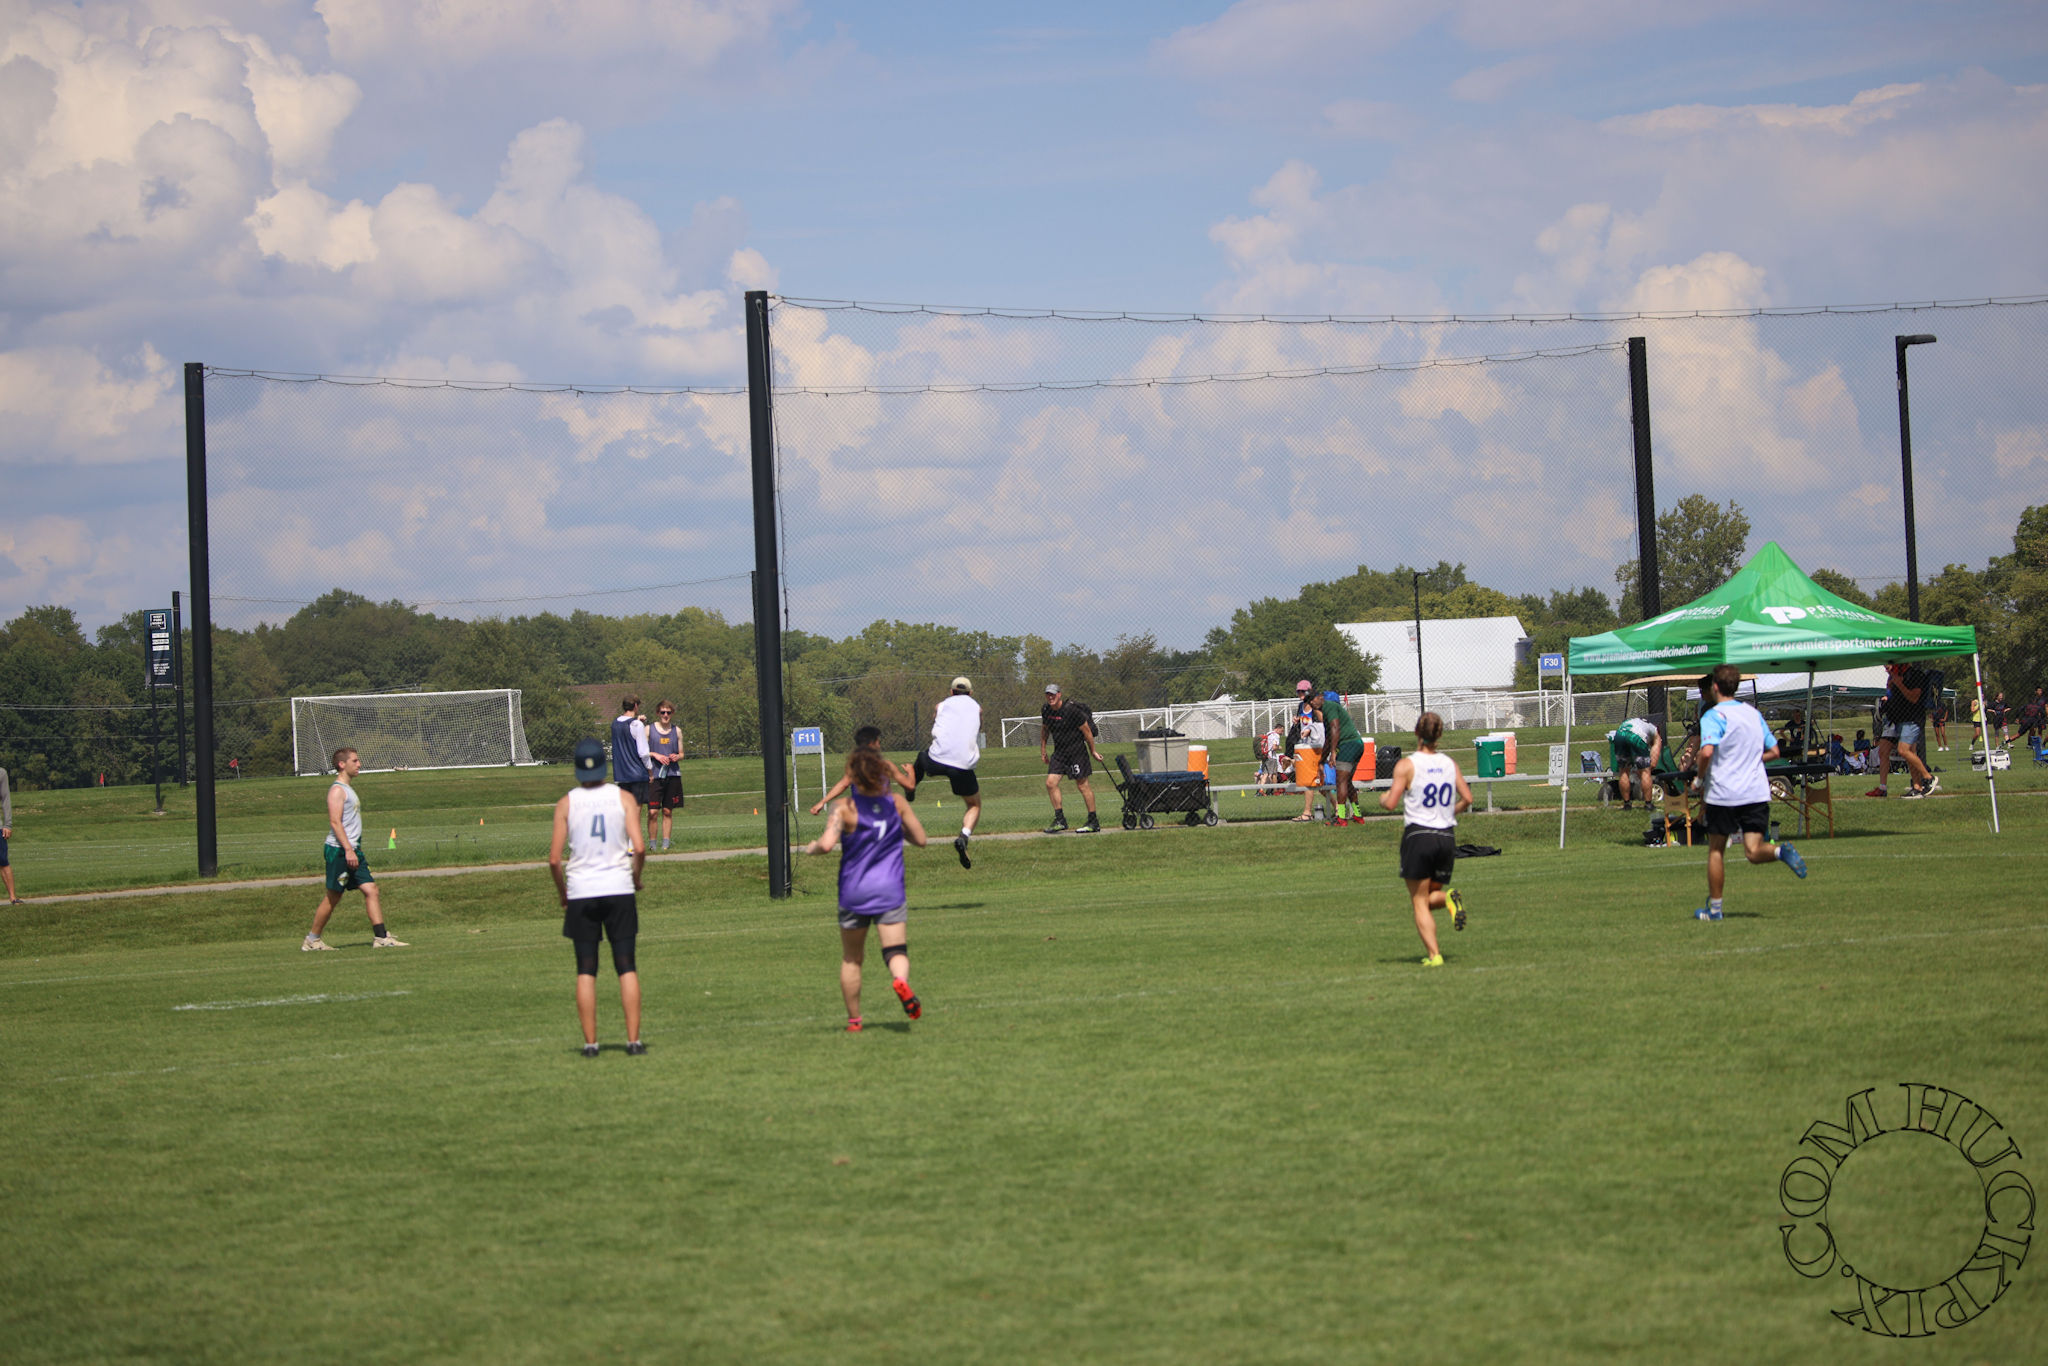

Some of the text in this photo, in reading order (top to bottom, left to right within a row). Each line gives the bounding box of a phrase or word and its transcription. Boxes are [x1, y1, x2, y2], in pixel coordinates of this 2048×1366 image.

[1806, 605, 1876, 621] PREMIER
[1752, 637, 1953, 652] www.premiersportsmedicinellc.com
[1544, 658, 1558, 666] F30
[1584, 644, 1708, 664] www.premiersportsmedicinellc.com
[798, 733, 815, 743] F11
[1422, 783, 1452, 808] 80
[590, 814, 606, 842] 4
[873, 820, 887, 840] 7
